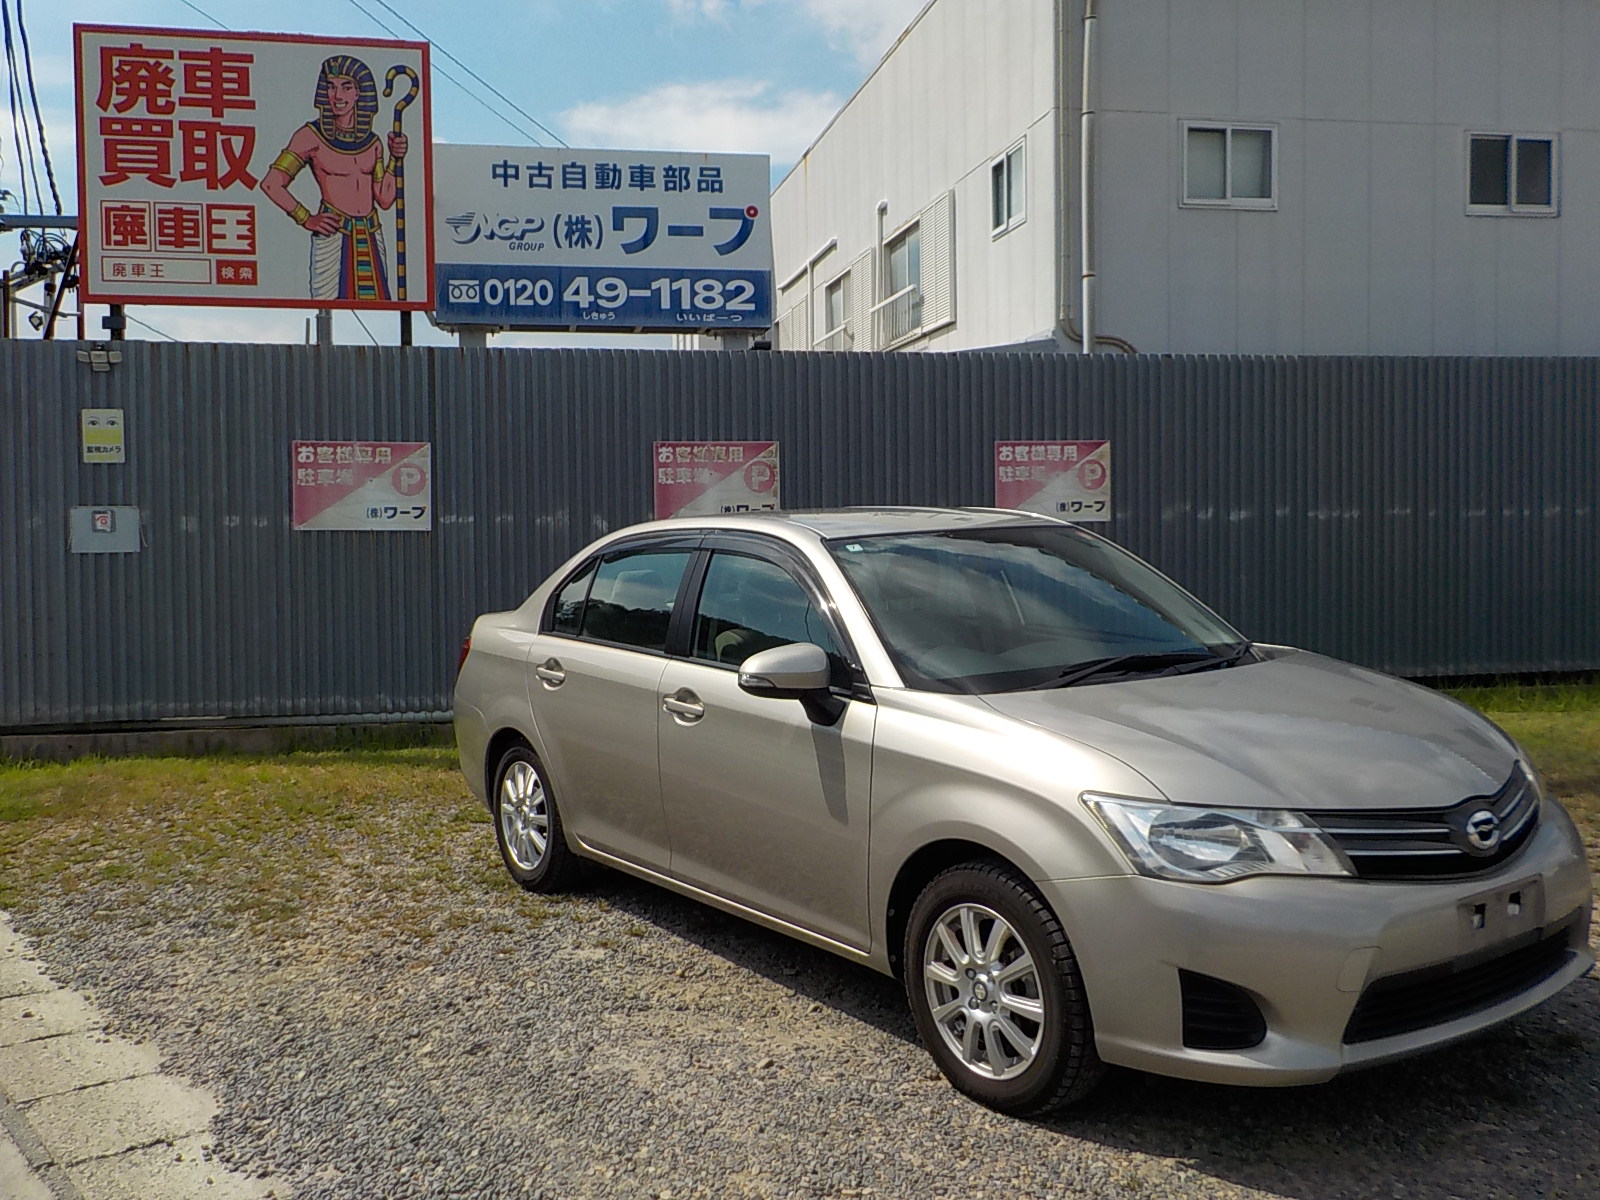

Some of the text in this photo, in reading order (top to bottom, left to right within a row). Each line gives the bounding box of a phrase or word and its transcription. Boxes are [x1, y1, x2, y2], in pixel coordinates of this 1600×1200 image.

[96, 43, 256, 118] 廃車
[98, 116, 259, 191] 買取
[491, 159, 724, 193] 中古自動車部品
[101, 200, 257, 255] 廃車王
[508, 241, 545, 251] GROUP
[112, 263, 165, 278] 廃車王
[220, 266, 254, 280] 検索
[484, 278, 554, 306] 0120
[582, 311, 616, 320] しきゅう
[999, 445, 1078, 461] お客様専用
[400, 467, 421, 492] P
[751, 465, 771, 490] P
[1084, 463, 1102, 486] P
